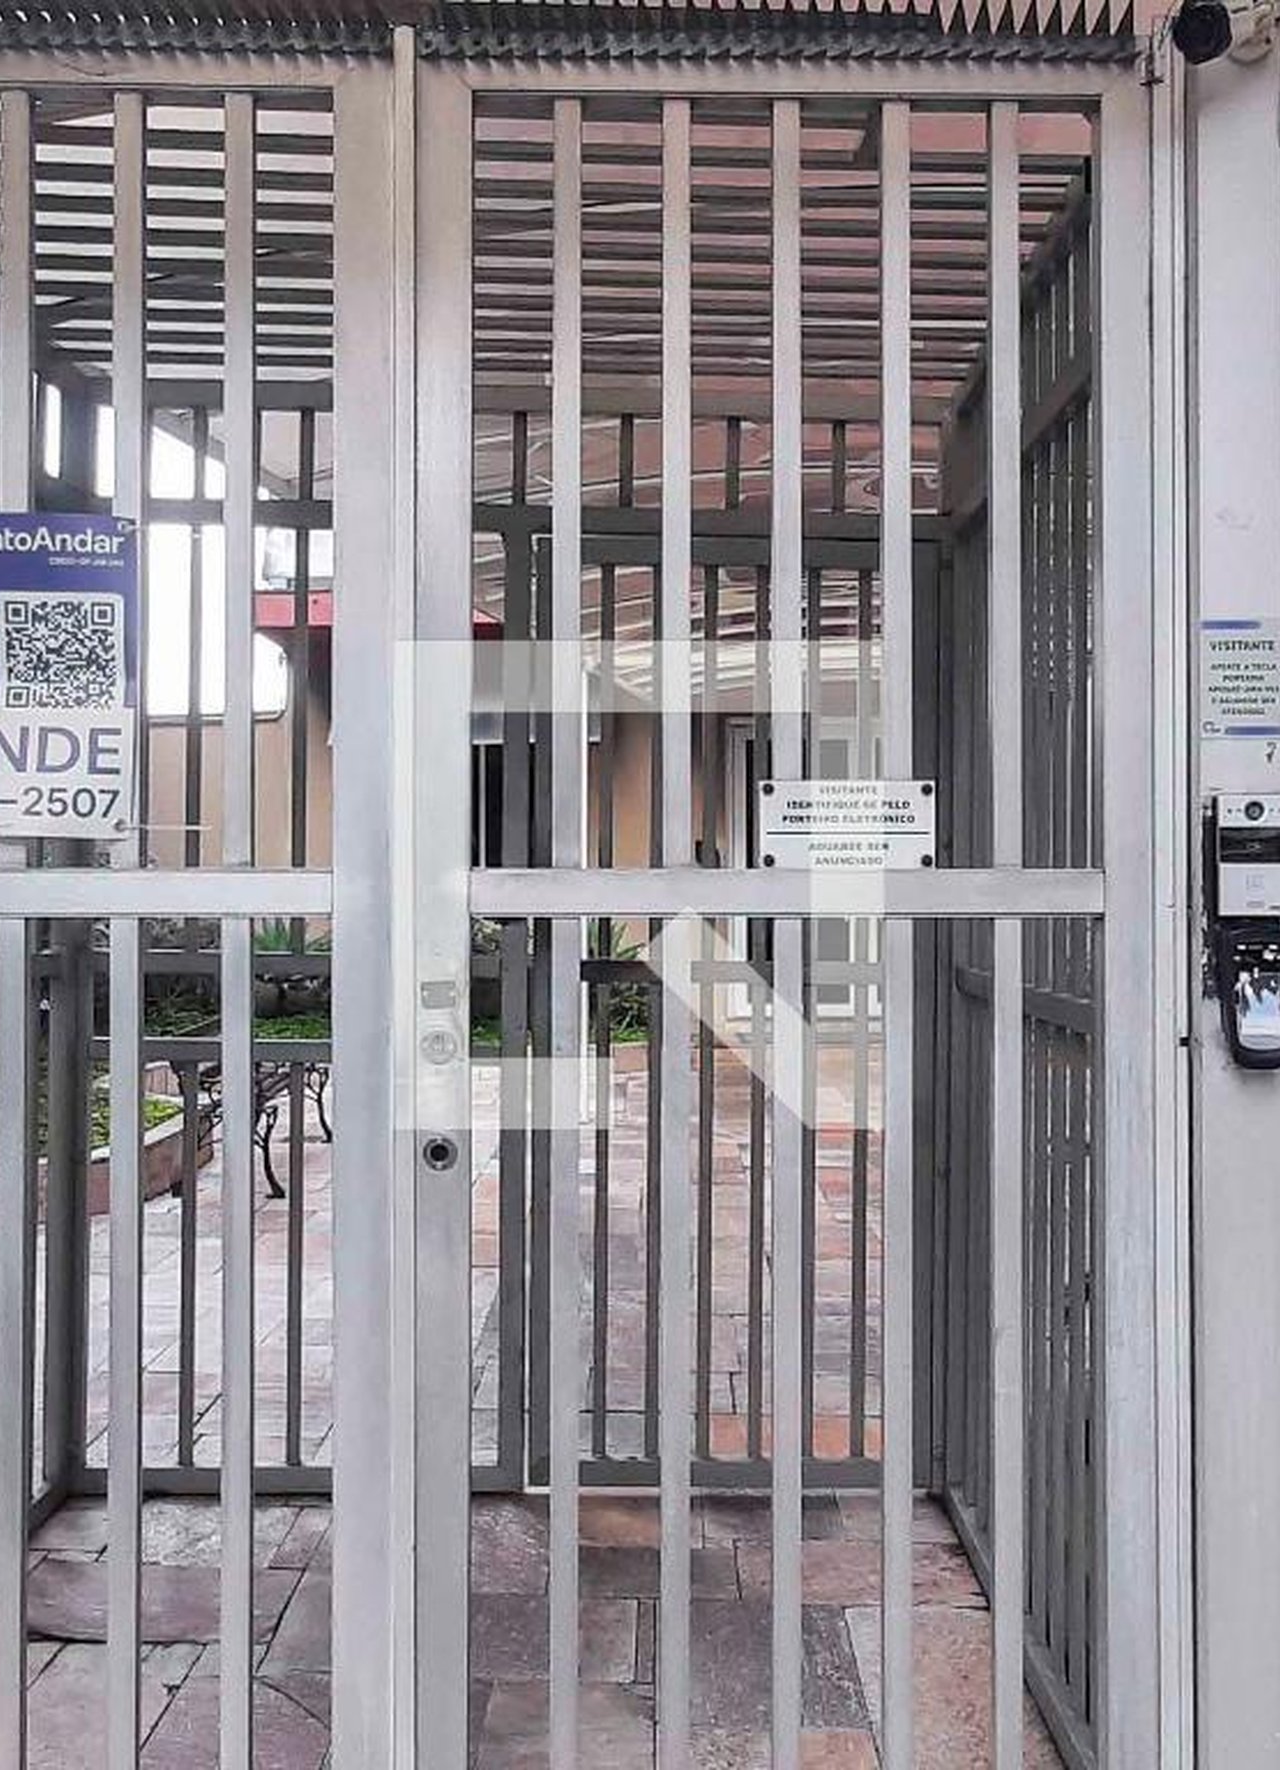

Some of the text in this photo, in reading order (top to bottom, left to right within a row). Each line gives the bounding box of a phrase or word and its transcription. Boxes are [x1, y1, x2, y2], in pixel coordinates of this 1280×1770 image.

[1210, 641, 1275, 651] VISITANTE
[819, 786, 878, 794] VISITANTE
[815, 857, 883, 865] ANUNCIADO
